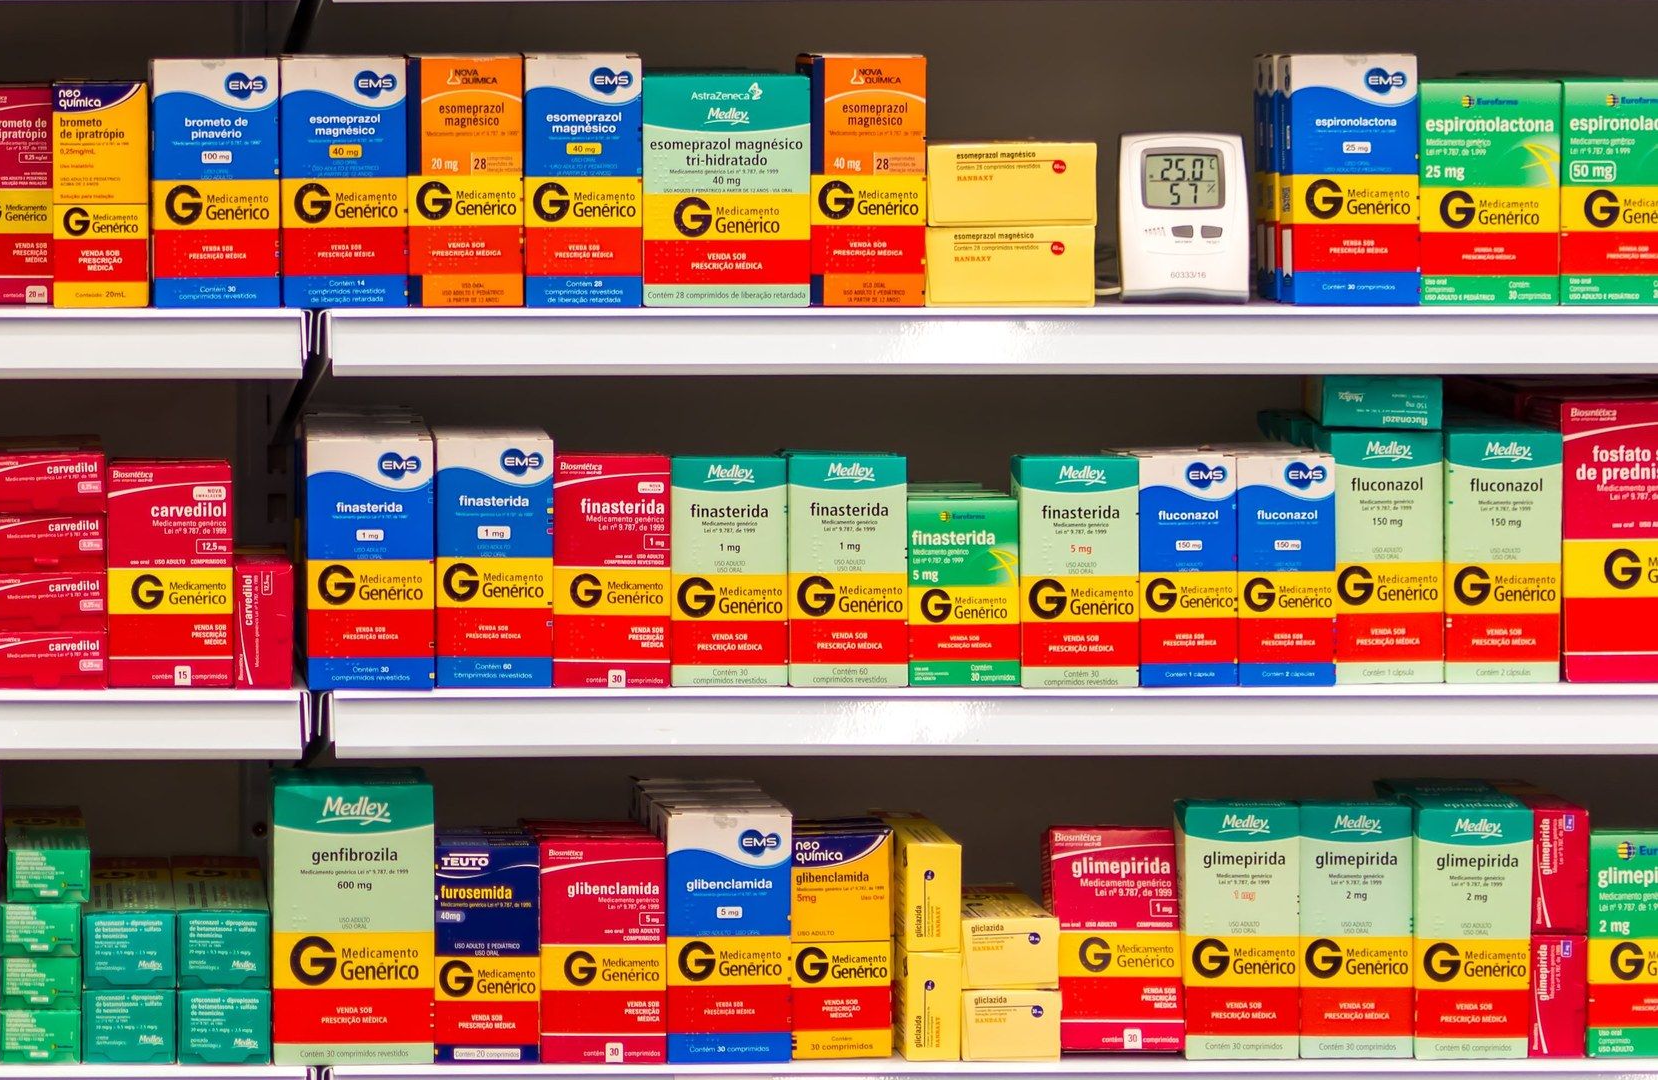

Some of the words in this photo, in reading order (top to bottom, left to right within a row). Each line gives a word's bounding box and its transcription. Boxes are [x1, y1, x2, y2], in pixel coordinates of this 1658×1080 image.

[691, 91, 750, 100] AstraZeneca
[184, 117, 228, 128] brometo
[232, 117, 248, 128] de
[1315, 117, 1397, 128] espironolactona
[191, 129, 242, 140] pinavério
[686, 154, 767, 166] tri-hidratado
[1170, 184, 1199, 206] 57
[1170, 271, 1207, 279] 60333/16
[1383, 416, 1428, 426] fluconazol
[1593, 445, 1651, 462] fosfato
[1351, 477, 1423, 491] fluconazol
[459, 495, 529, 507] finasterida
[690, 504, 768, 518] finasterida
[913, 570, 919, 580] 5
[922, 571, 938, 582] mg
[243, 575, 253, 626] carvedilol
[178, 670, 188, 680] 15
[312, 847, 398, 865] genfibrozila
[1203, 851, 1285, 869] glimepirida
[337, 880, 352, 890] 600
[357, 883, 372, 891] mg
[567, 882, 659, 898] glibenclamida
[440, 885, 513, 899] furosemida
[1346, 891, 1351, 899] 2
[1354, 893, 1367, 901] mg
[971, 924, 1004, 934] gliclazida
[609, 1047, 619, 1058] 30
